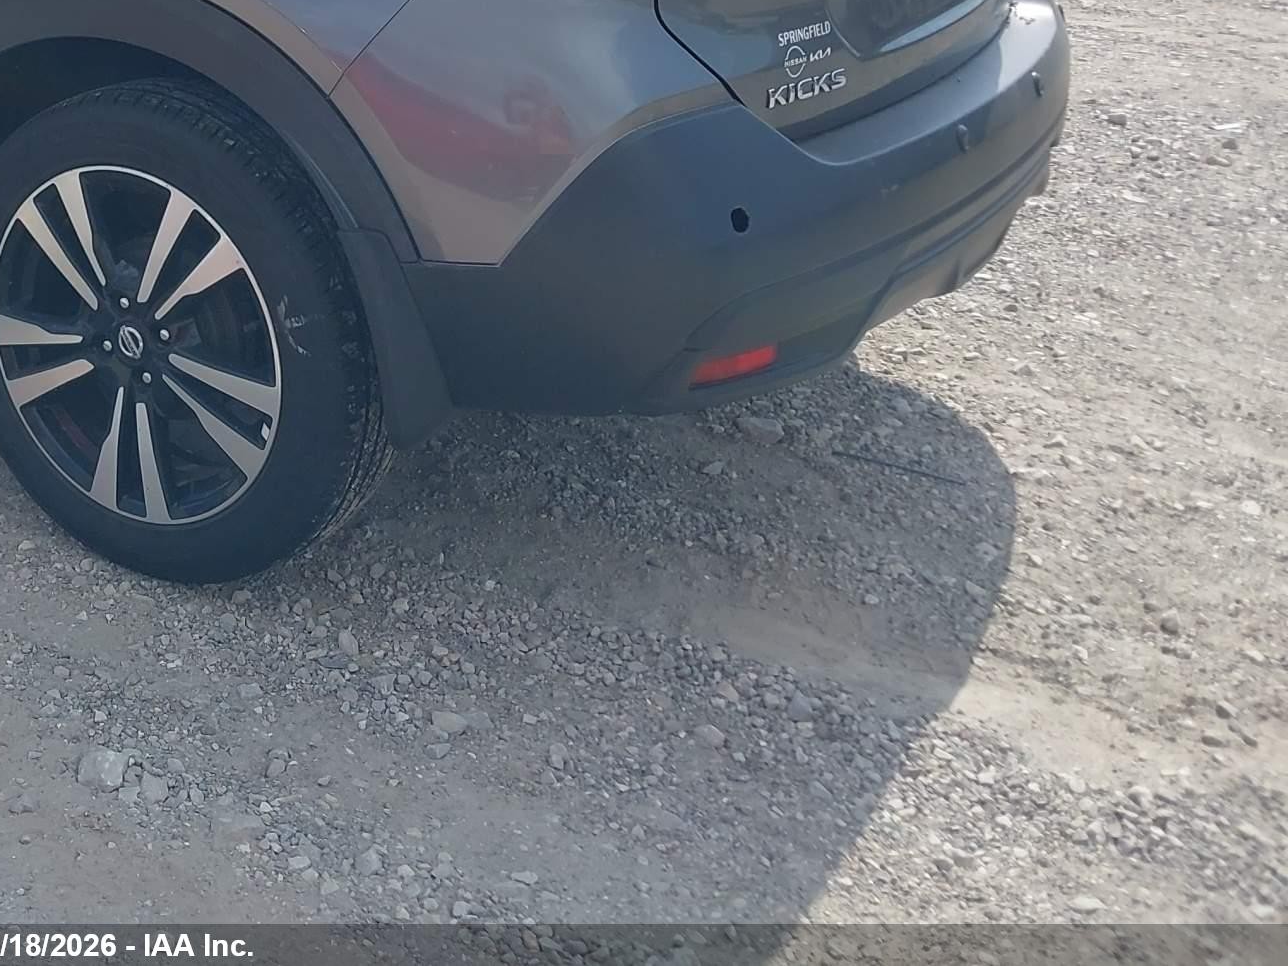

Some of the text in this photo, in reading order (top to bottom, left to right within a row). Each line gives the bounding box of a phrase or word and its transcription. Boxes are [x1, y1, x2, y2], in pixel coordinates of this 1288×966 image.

[778, 20, 831, 47] SPRINGFIELD
[784, 56, 808, 68] NISSAN
[767, 68, 848, 109] KICKS
